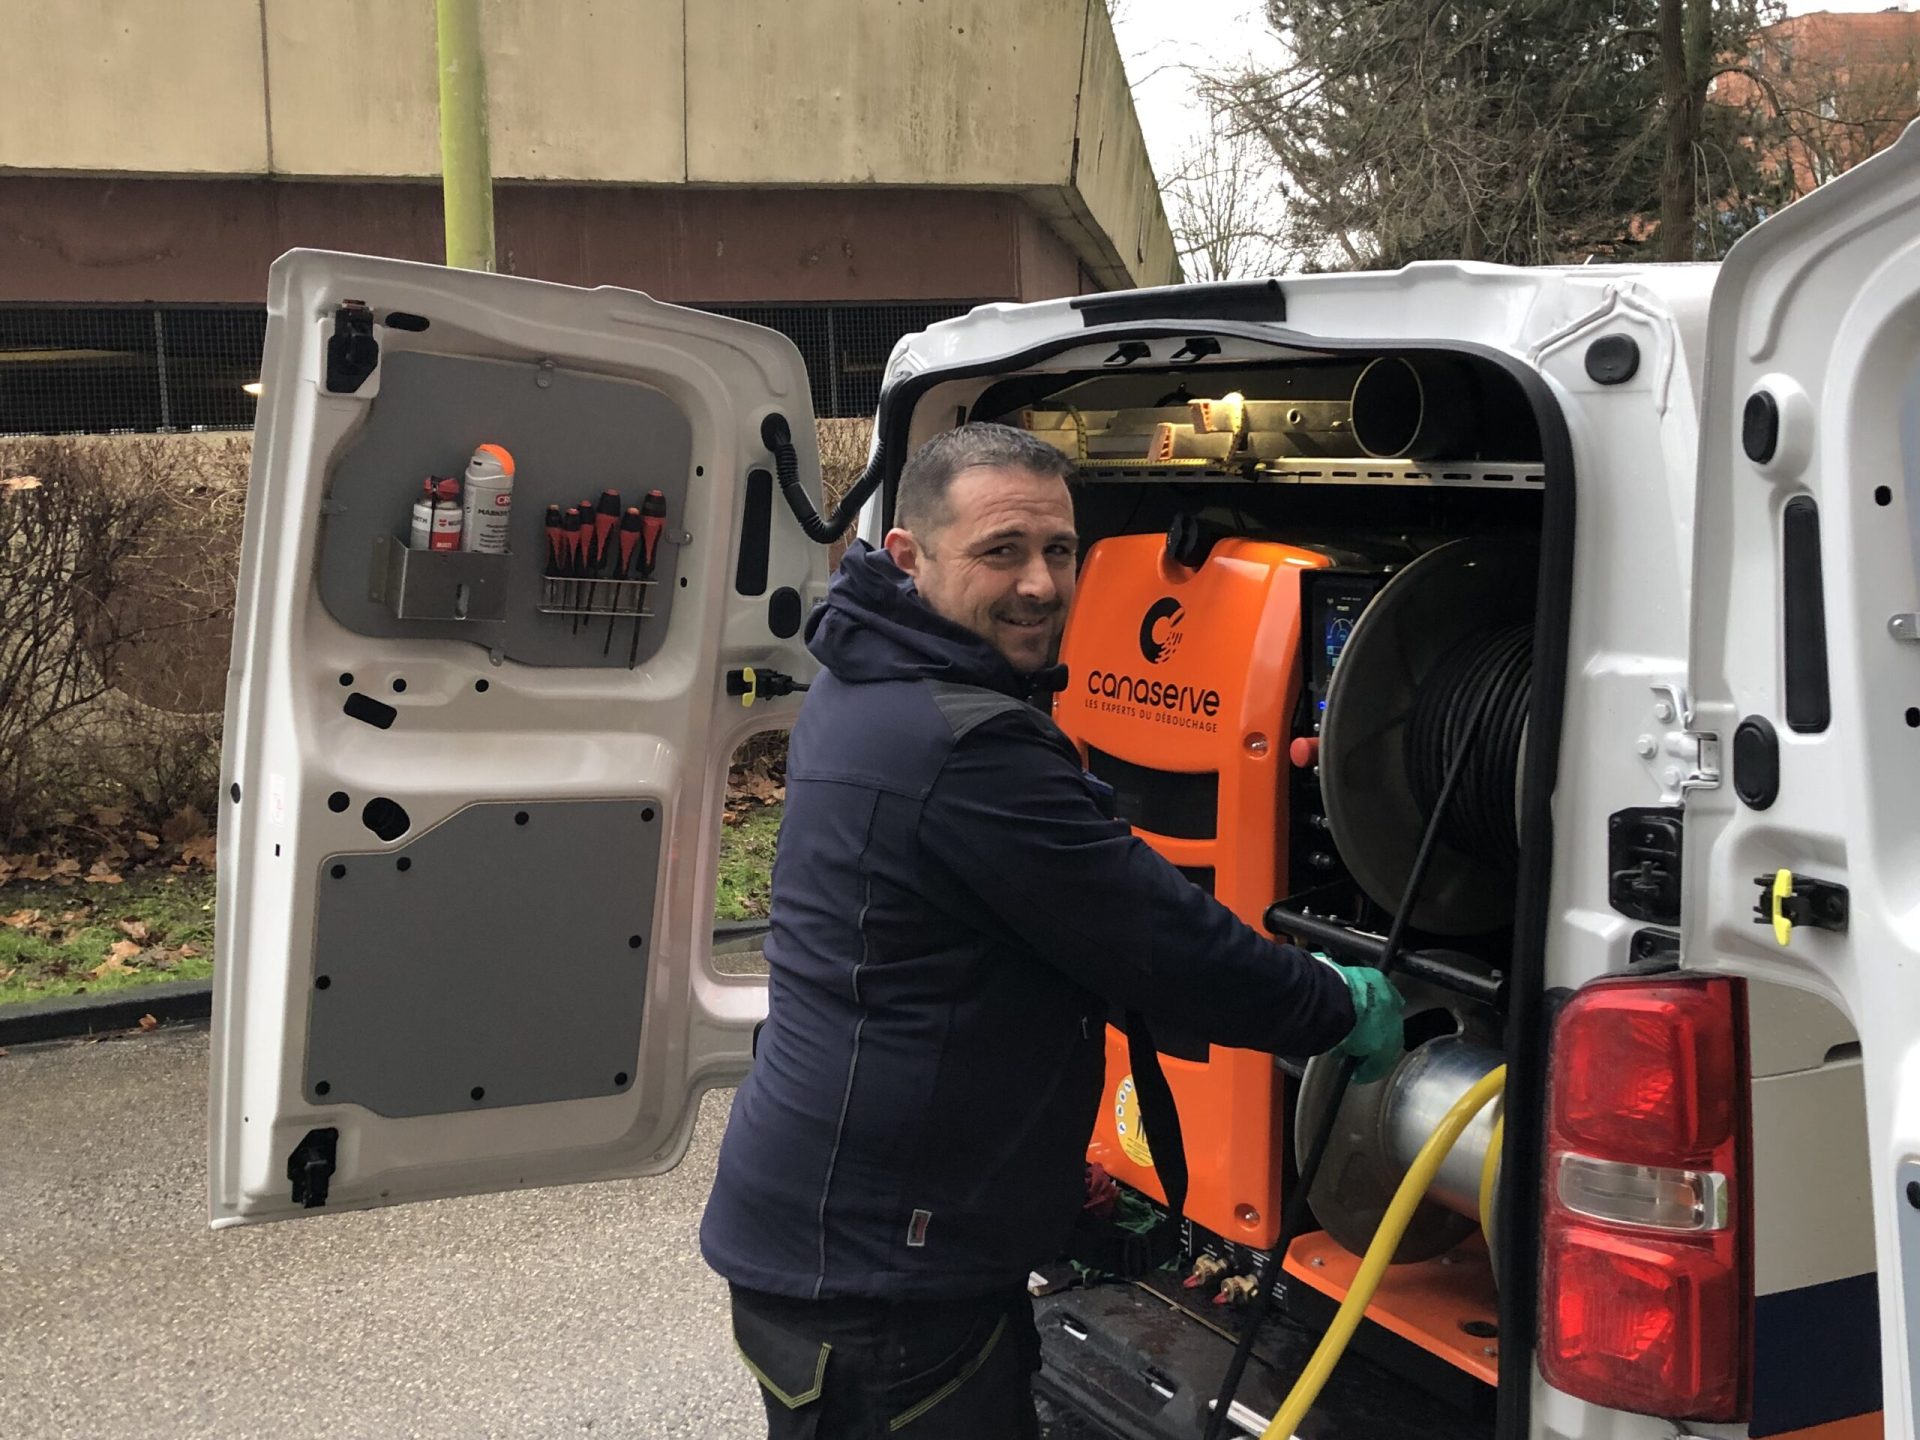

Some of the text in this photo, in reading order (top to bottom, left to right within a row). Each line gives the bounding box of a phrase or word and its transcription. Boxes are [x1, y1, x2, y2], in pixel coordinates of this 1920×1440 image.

[1088, 671, 1220, 716] canaserve
[1085, 698, 1217, 733] LES EXPERTS DU DÉBOUCHAGE
